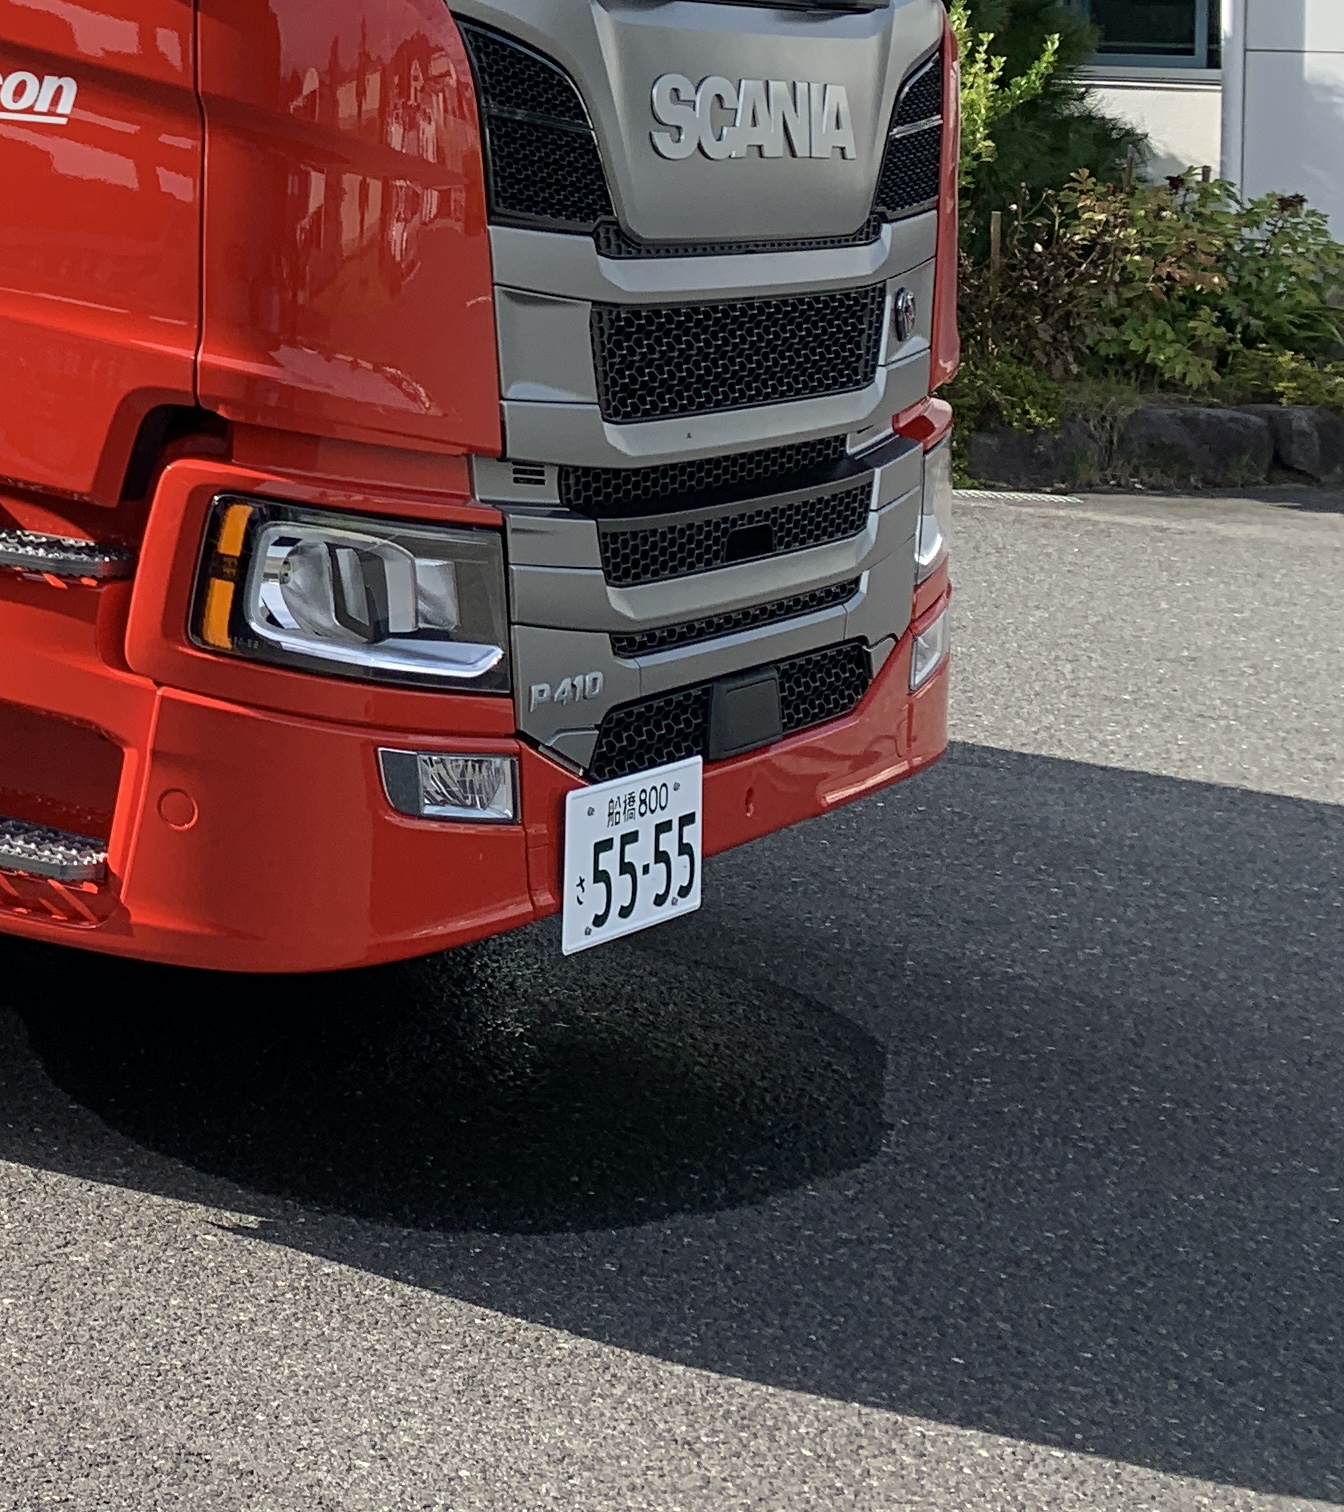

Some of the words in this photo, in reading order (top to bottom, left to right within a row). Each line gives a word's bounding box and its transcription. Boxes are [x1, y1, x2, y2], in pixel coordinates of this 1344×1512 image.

[649, 72, 857, 162] SCANIA
[529, 670, 605, 714] P410
[575, 875, 586, 906] さ
[591, 810, 697, 929] 55-55
